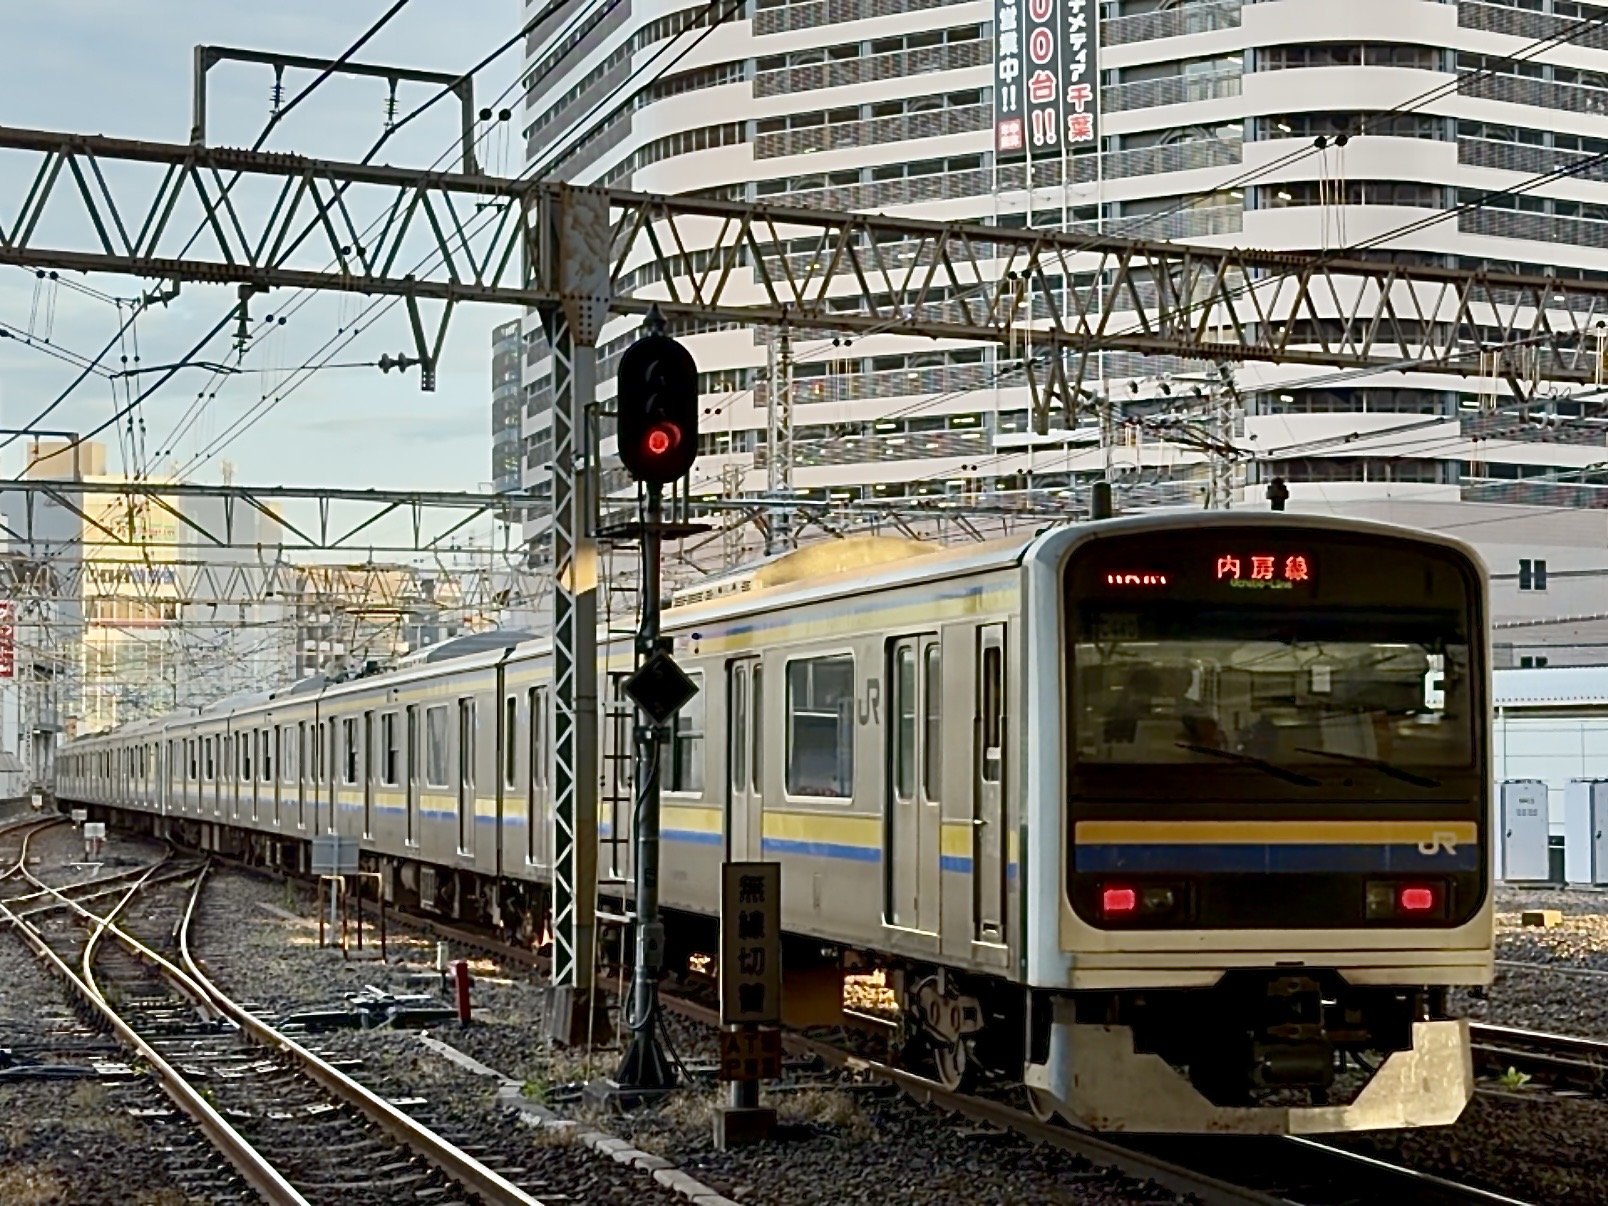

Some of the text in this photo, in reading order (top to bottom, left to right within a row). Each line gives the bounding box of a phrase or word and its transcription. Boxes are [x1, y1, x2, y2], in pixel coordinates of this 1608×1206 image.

[999, 0, 1019, 112] 営業中!!
[1217, 555, 1308, 580] 内房線
[858, 678, 880, 726] JR
[1418, 832, 1457, 855] JR
